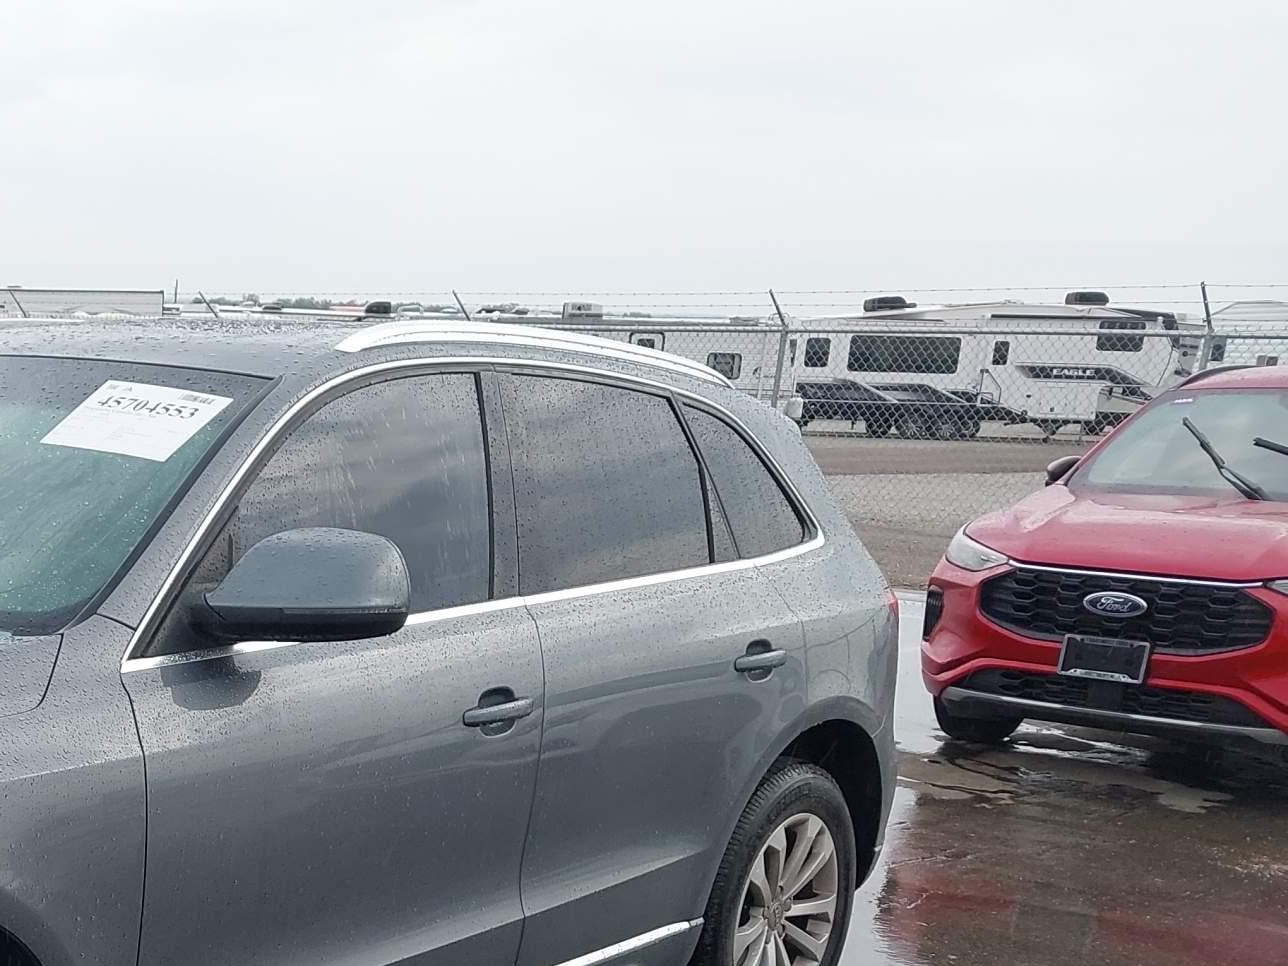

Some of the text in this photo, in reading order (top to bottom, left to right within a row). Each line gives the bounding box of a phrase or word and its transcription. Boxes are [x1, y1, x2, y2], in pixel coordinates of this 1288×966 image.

[1052, 368, 1097, 376] EAGLE
[97, 395, 200, 419] 45704553
[1096, 596, 1133, 612] Ford
